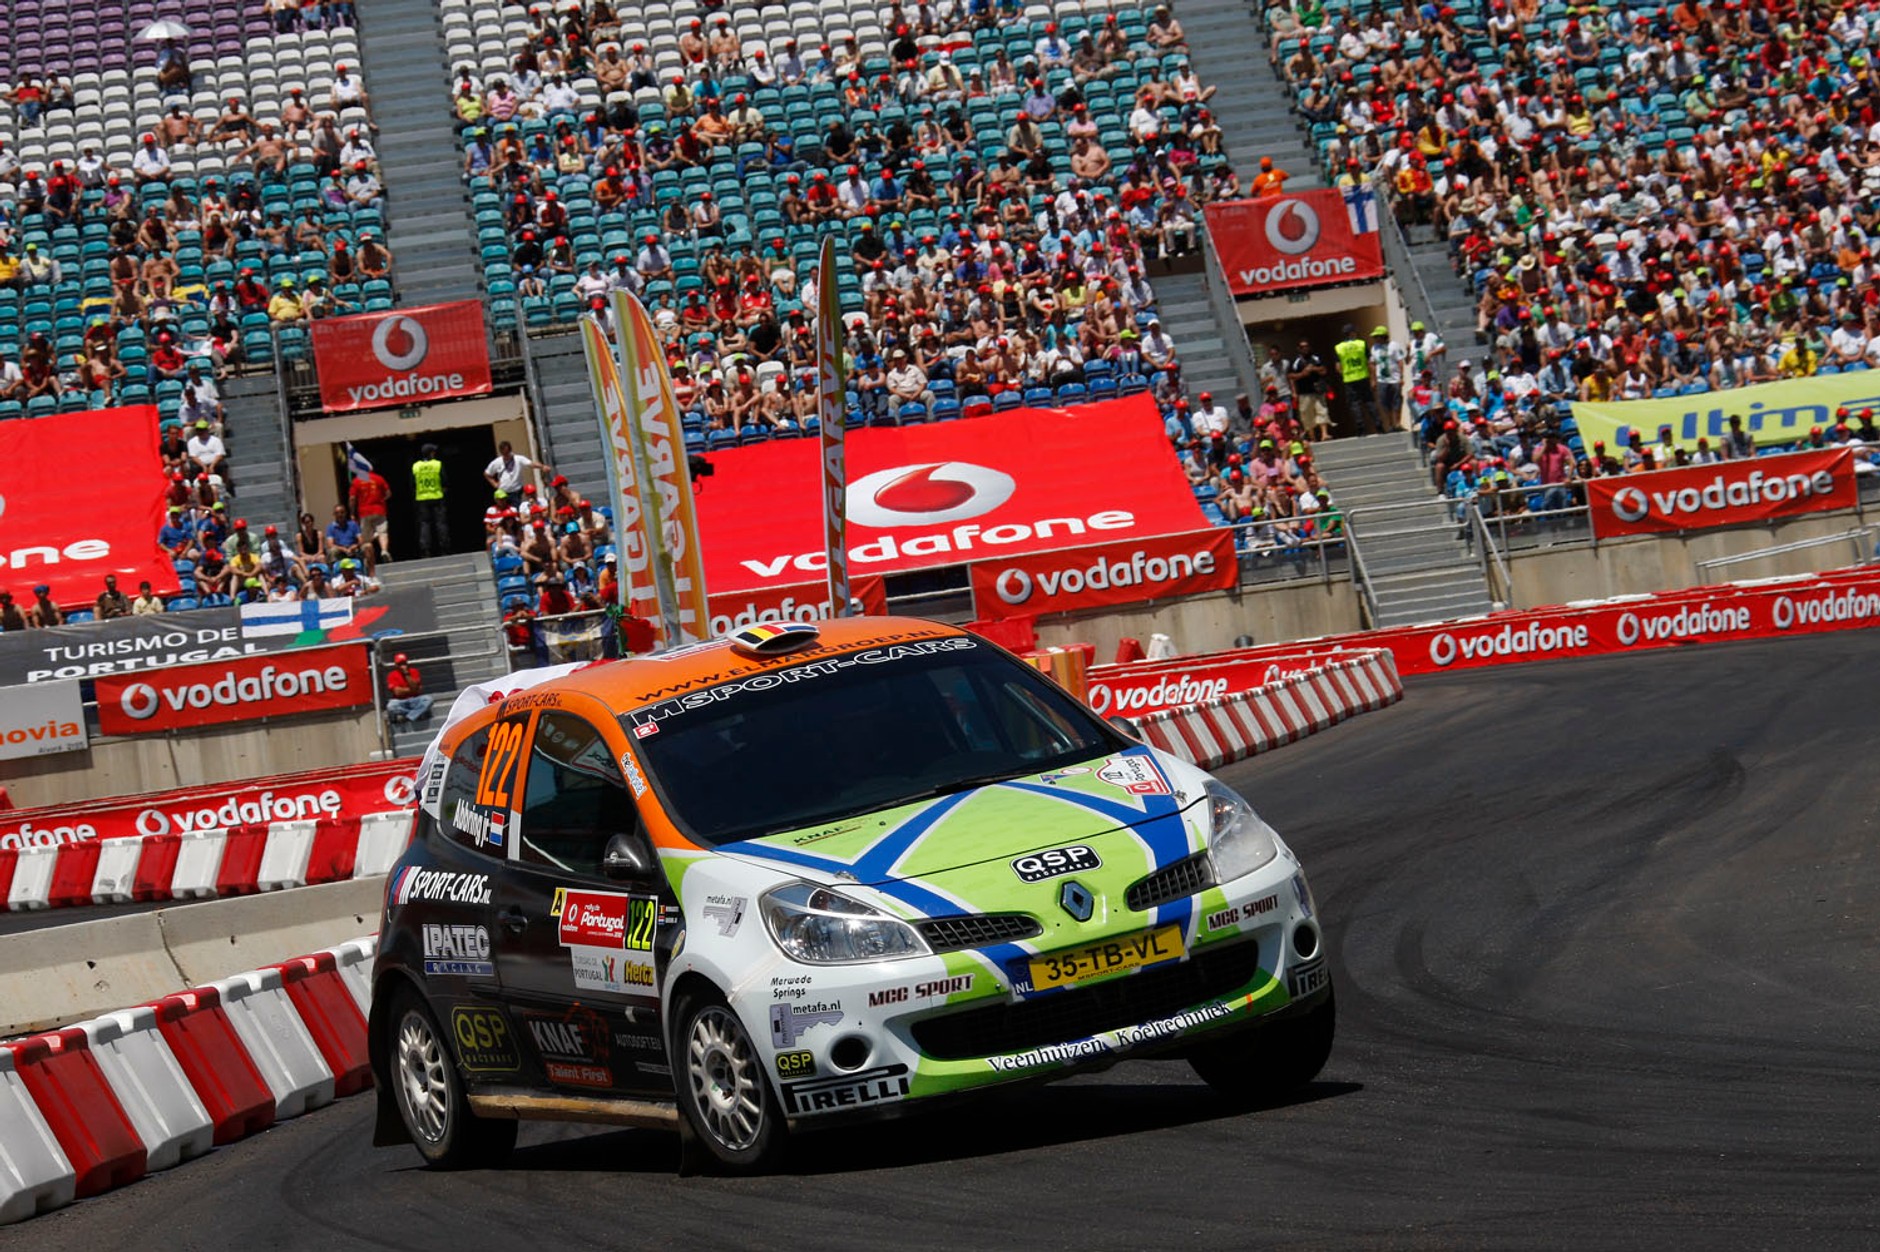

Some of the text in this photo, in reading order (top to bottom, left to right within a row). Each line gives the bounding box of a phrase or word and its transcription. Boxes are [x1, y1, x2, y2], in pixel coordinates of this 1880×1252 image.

[1240, 256, 1356, 286] vodafone
[348, 373, 463, 404] vodafone
[1653, 469, 1833, 515] vodafone
[0, 539, 111, 569] ne
[741, 510, 1135, 578] vodafone
[1037, 550, 1215, 597] vodafone
[1641, 603, 1750, 641] vodafone
[1796, 587, 1880, 624] vodafon
[43, 627, 238, 663] TURISMO DE
[1459, 622, 1588, 660] vodafone
[27, 643, 267, 683] PORTUGAL
[163, 665, 348, 711] vodafone
[631, 637, 978, 726] MSPORT-CARS
[1115, 675, 1228, 711] vodafone
[0, 720, 79, 746] ovia
[476, 721, 523, 808] 122
[172, 789, 341, 832] vodafone
[1016, 847, 1089, 873] QSP
[580, 911, 625, 932] Portugal
[1242, 893, 1279, 919] SPORT
[422, 924, 490, 960] IPATEC
[627, 899, 656, 951] 122
[624, 960, 654, 987] Hertz
[1044, 933, 1169, 981] 35-TB-VL
[773, 986, 806, 1000] Springs
[915, 974, 975, 999] SPORT
[1015, 981, 1034, 994] NL
[793, 1000, 841, 1014] metafa.nl
[1115, 1001, 1233, 1047] Koeltechniek
[456, 1013, 506, 1051] QSP
[528, 1020, 585, 1056] KNAF
[546, 1063, 608, 1082] Talent First
[777, 1052, 812, 1071] QSP
[780, 1063, 909, 1114] PIRELLI
